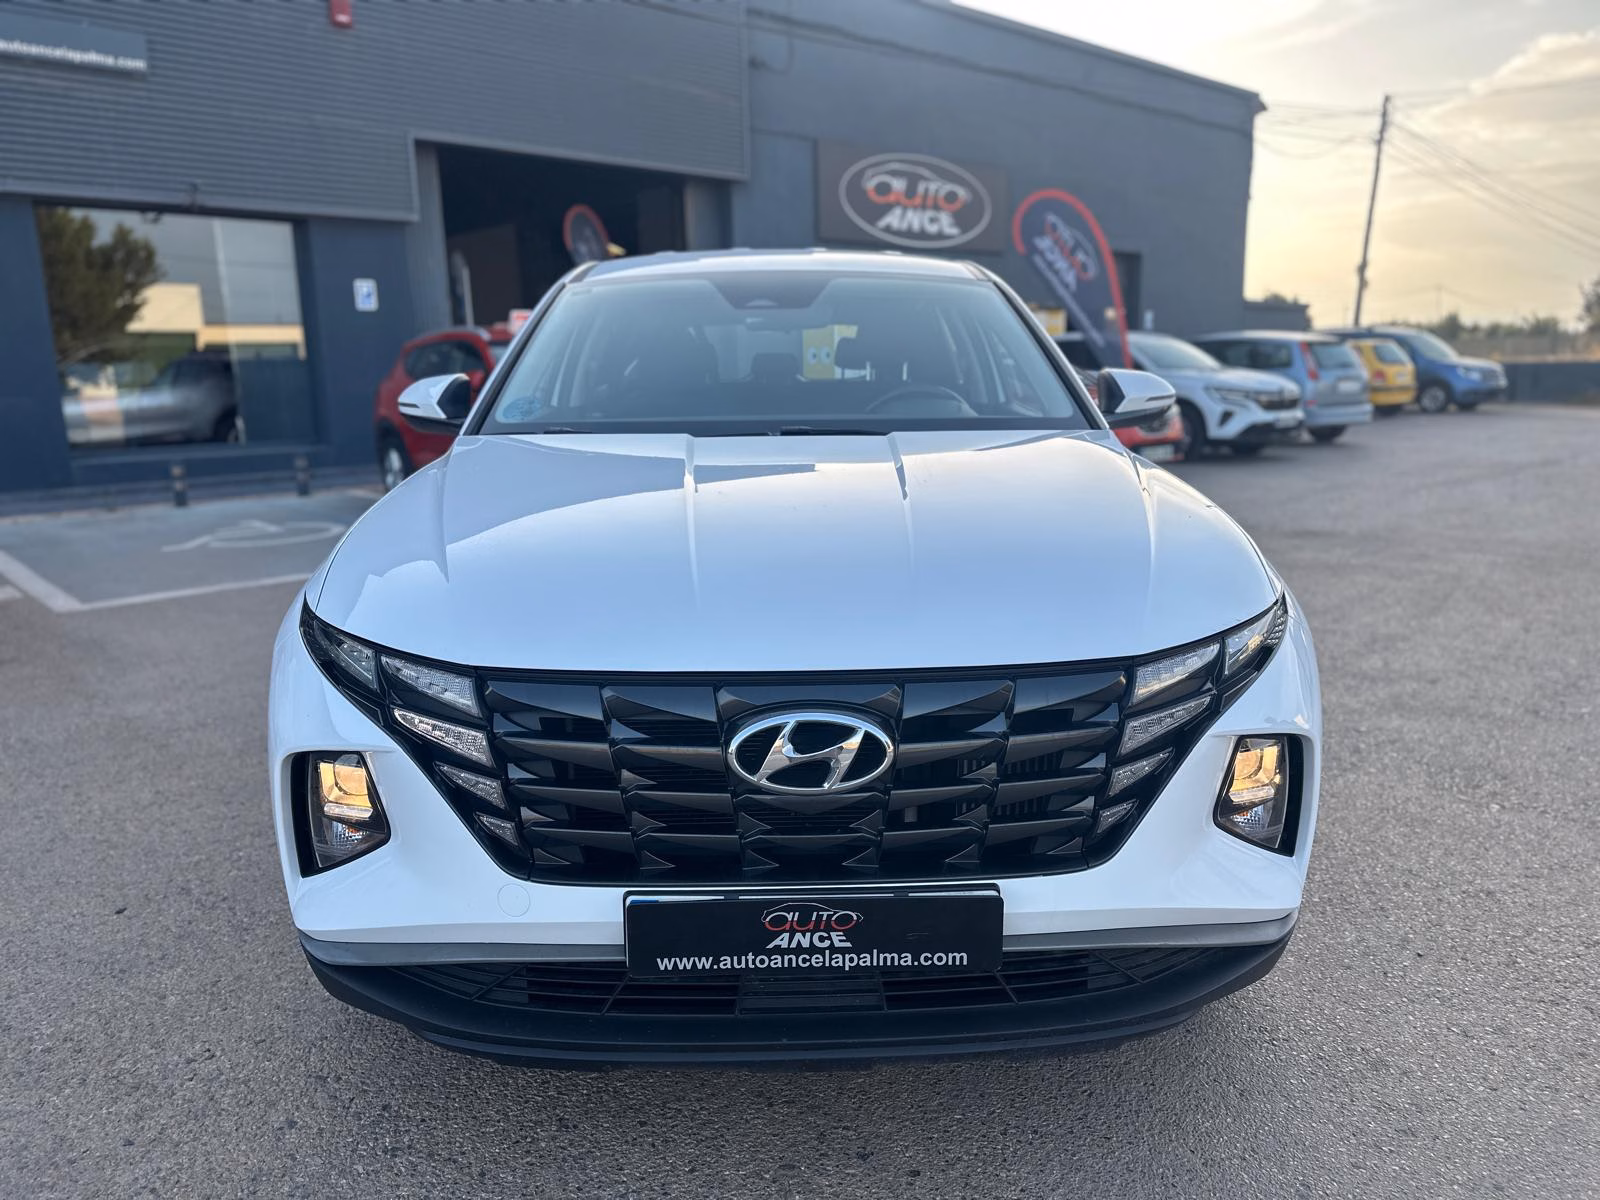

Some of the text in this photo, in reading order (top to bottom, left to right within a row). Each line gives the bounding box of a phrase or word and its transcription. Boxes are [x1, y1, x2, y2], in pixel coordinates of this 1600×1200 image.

[875, 205, 961, 237] ANCE
[765, 932, 853, 949] ANCE
[656, 949, 968, 971] www.autoancelapalma.com
